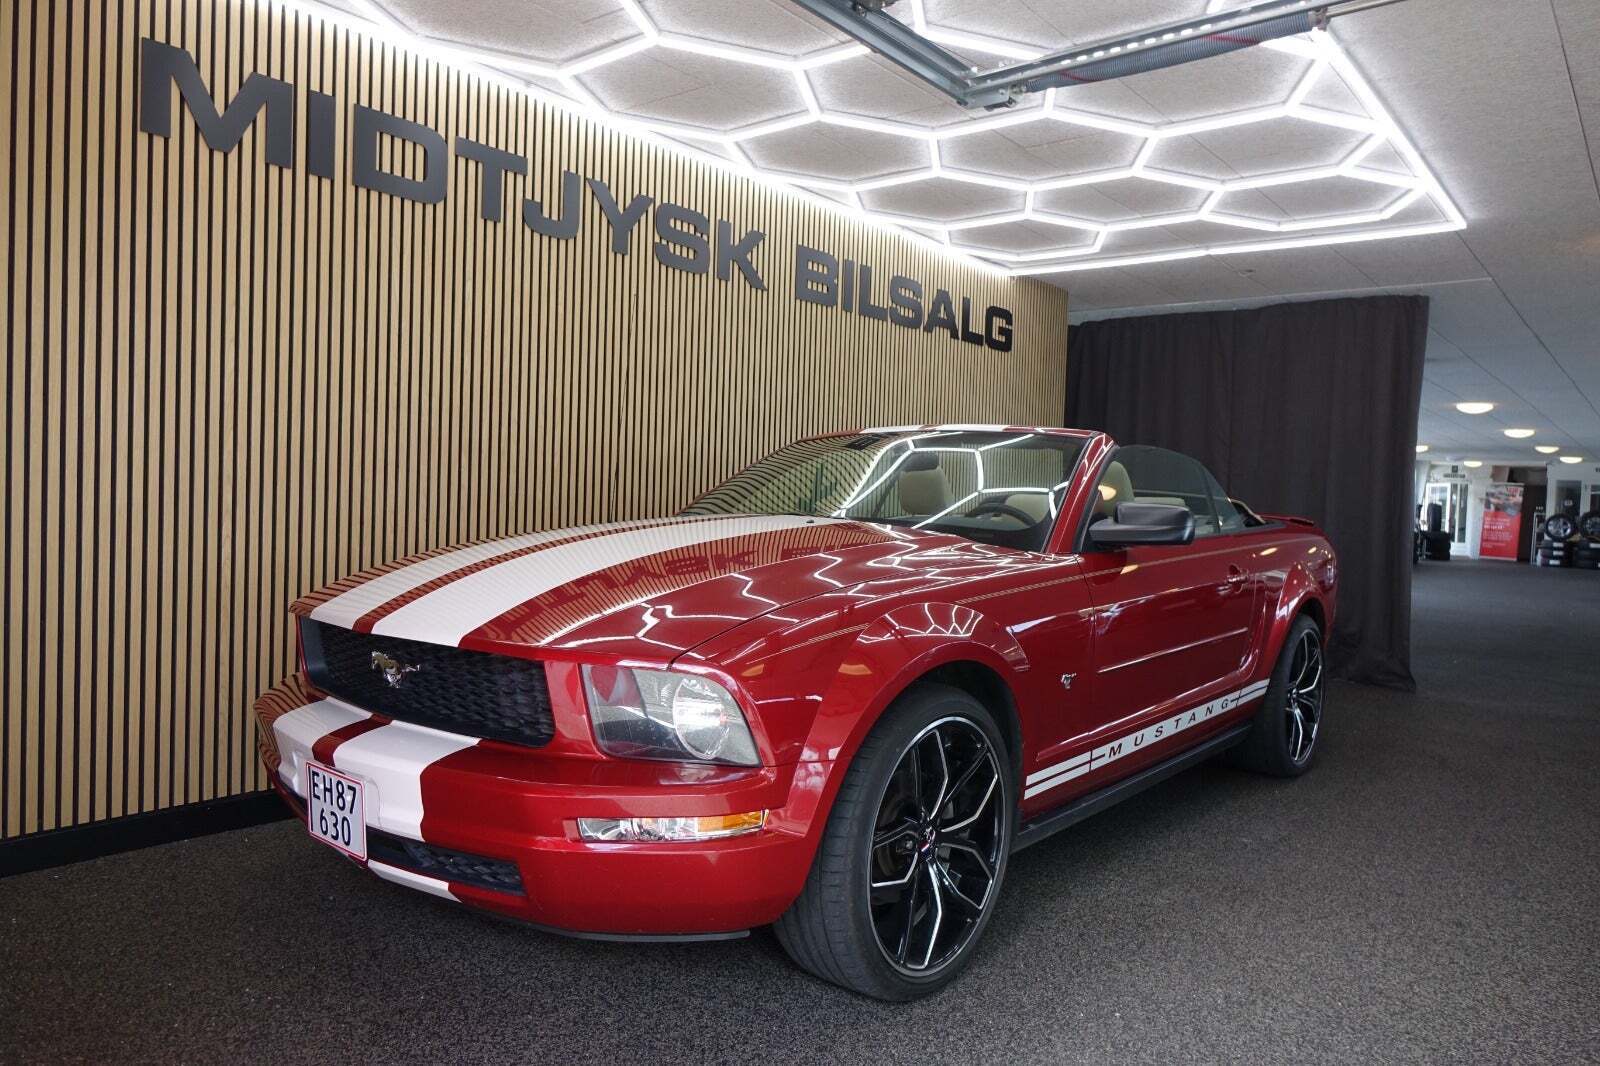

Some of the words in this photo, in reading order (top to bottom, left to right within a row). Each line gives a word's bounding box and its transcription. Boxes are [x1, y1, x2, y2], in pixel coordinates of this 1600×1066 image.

[140, 37, 767, 291] MIDTJYSK
[796, 243, 1013, 352] BILSALG
[1108, 698, 1229, 759] MUSTANG
[312, 770, 357, 815] EH87
[320, 808, 351, 846] 630
